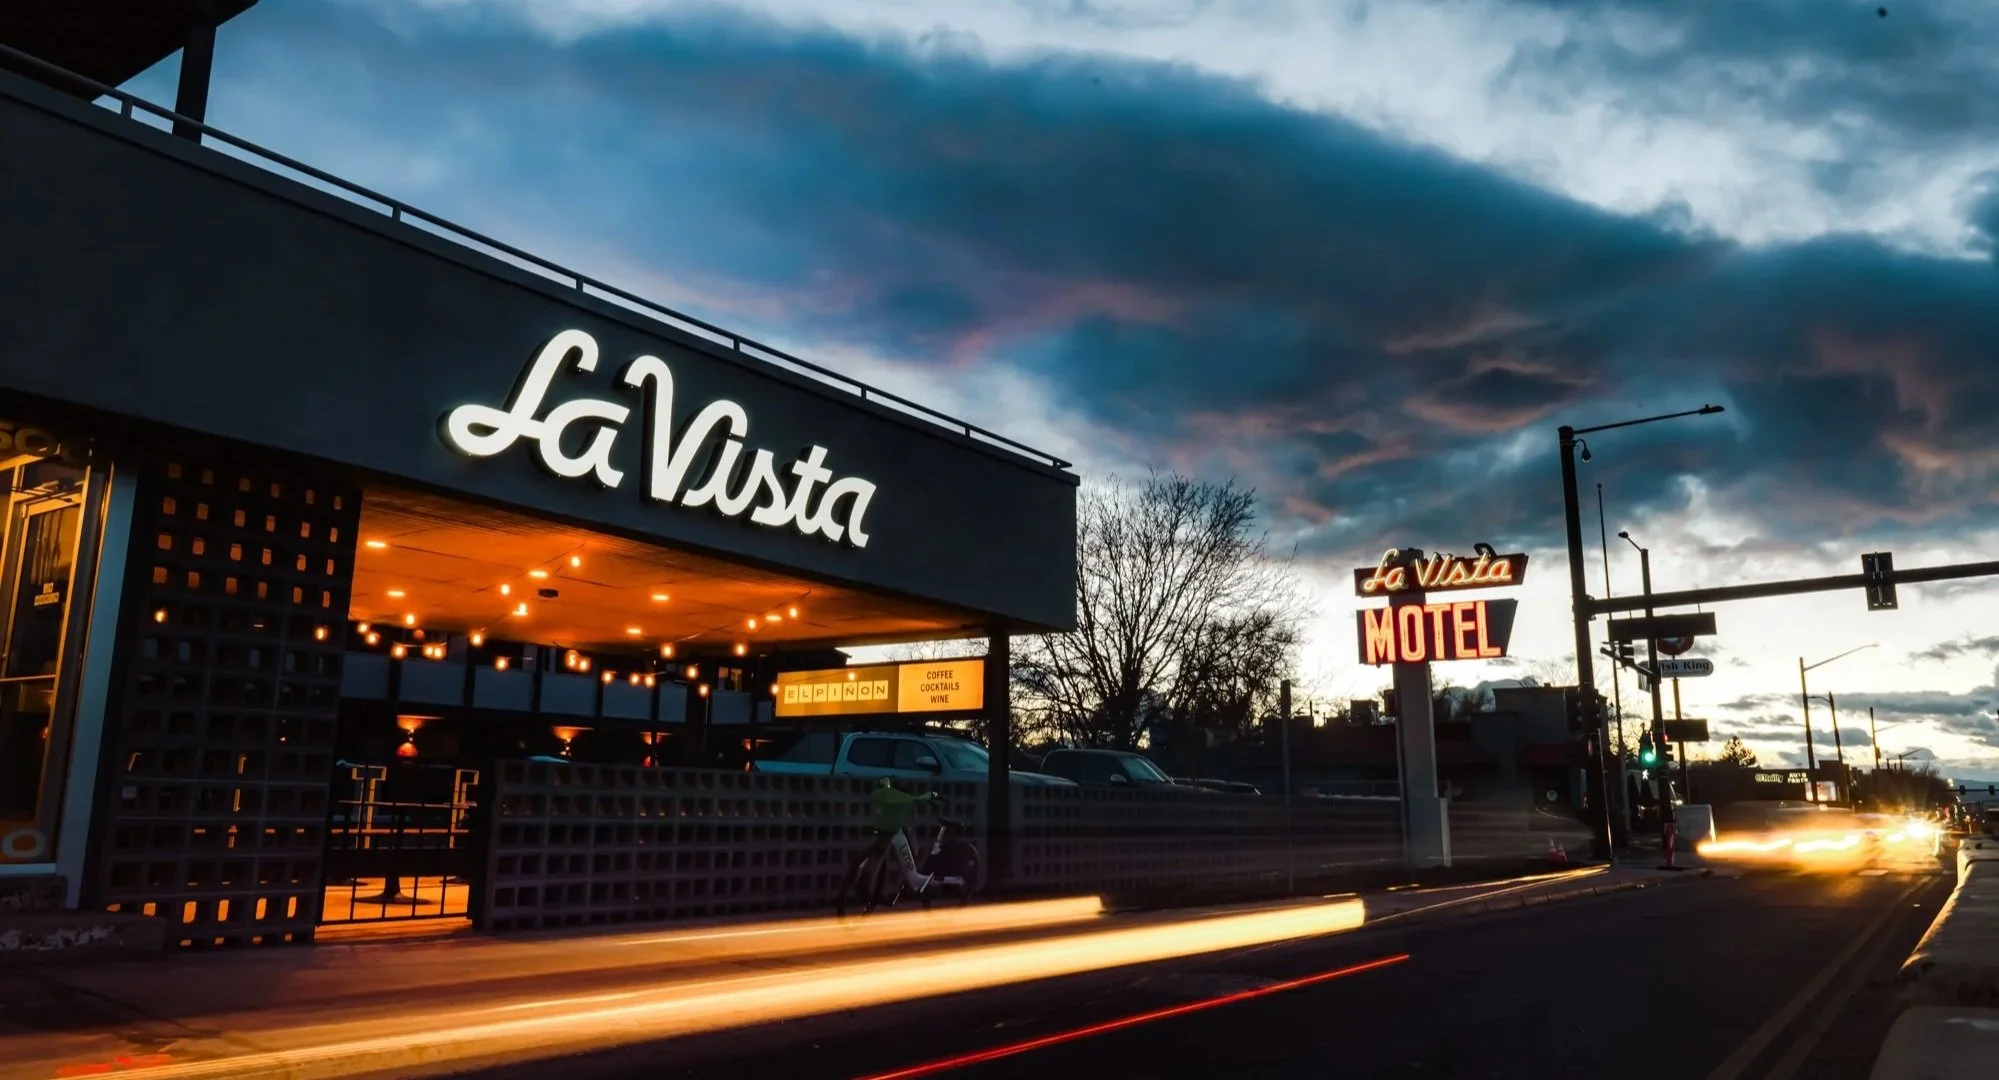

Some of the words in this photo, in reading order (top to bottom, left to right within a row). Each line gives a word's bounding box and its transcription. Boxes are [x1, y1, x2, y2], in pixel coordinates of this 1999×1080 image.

[449, 329, 630, 489] La
[624, 355, 877, 548] Vista
[1361, 548, 1405, 592] La
[1414, 551, 1513, 587] Vista
[1364, 600, 1502, 665] MOTEL
[1683, 660, 1710, 670] King
[926, 670, 954, 680] COFFEE
[920, 682, 960, 692] COCKTAILS
[930, 694, 949, 703] WINE
